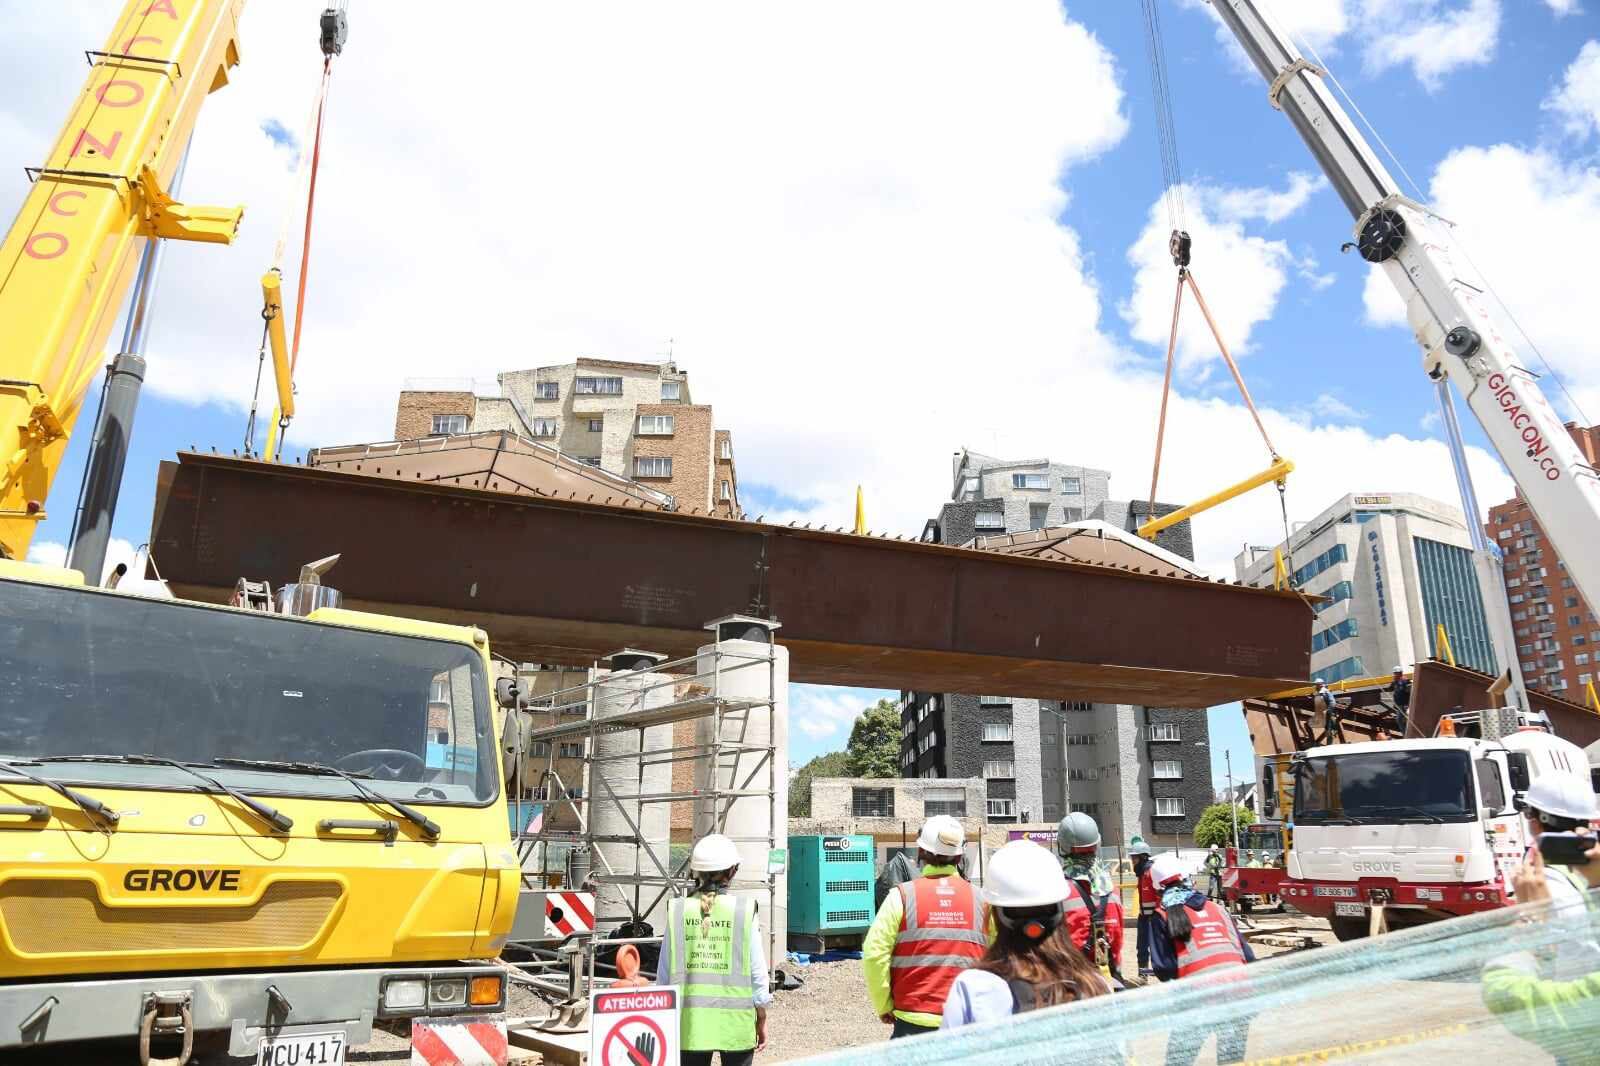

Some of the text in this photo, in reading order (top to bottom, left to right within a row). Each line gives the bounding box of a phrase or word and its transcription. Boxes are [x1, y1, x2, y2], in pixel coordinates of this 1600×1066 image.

[1488, 373, 1560, 481] GIGACON.CO
[1353, 861, 1401, 873] GROVE
[124, 869, 241, 892] GROVE
[604, 993, 668, 1010] ATENCIÓN!
